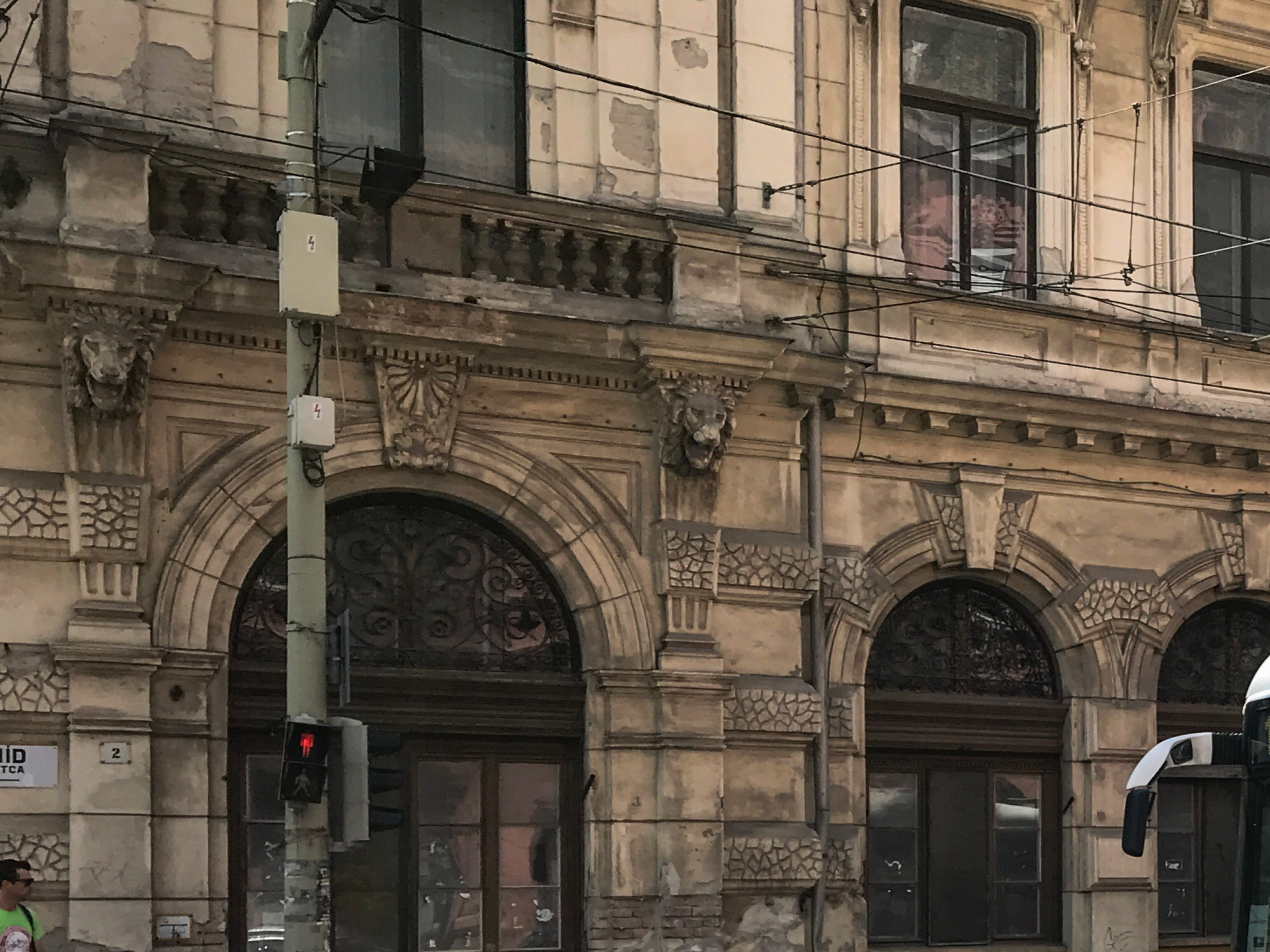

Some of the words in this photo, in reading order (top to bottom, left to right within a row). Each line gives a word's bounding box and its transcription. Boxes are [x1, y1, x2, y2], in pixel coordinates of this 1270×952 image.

[0, 745, 26, 763] ÍD
[111, 748, 121, 759] 2
[0, 765, 24, 774] TCA
